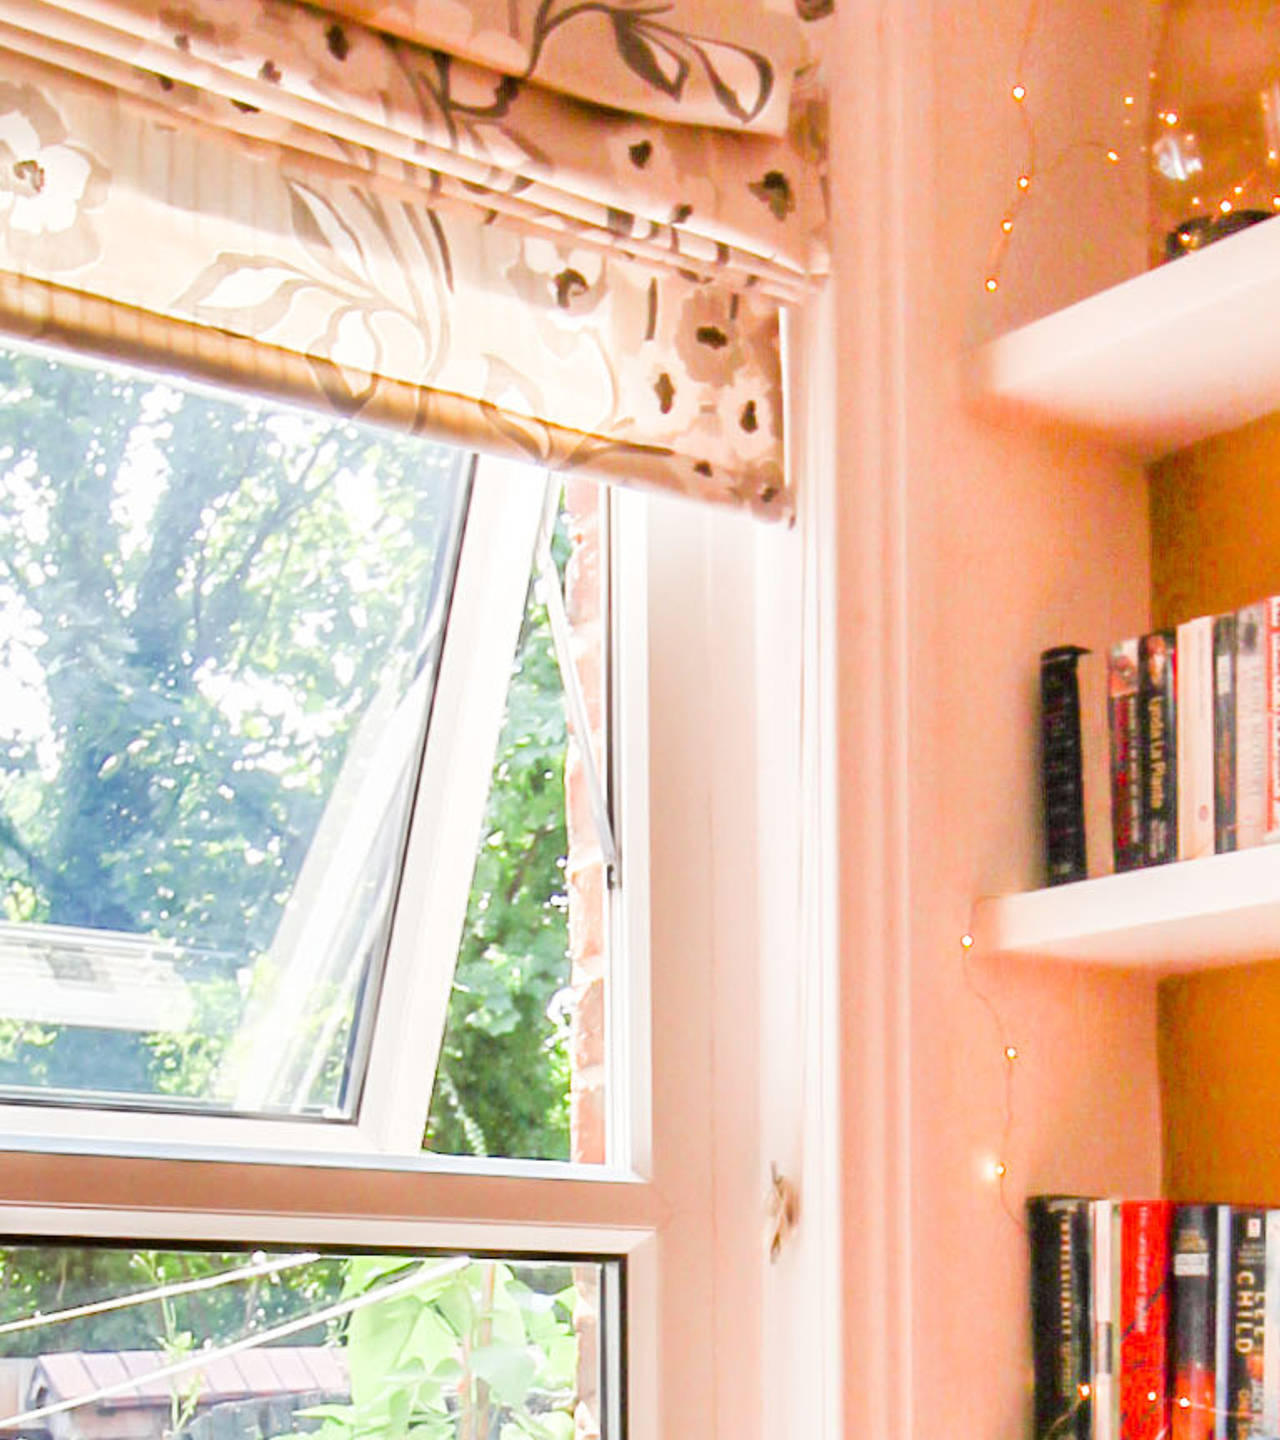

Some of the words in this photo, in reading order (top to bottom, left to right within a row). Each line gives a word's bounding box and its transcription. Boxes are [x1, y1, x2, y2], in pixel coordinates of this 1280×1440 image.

[1148, 696, 1165, 738] Lynda
[1150, 742, 1165, 759] La
[1150, 761, 1166, 809] Plante
[1236, 1271, 1254, 1354] CHILD
